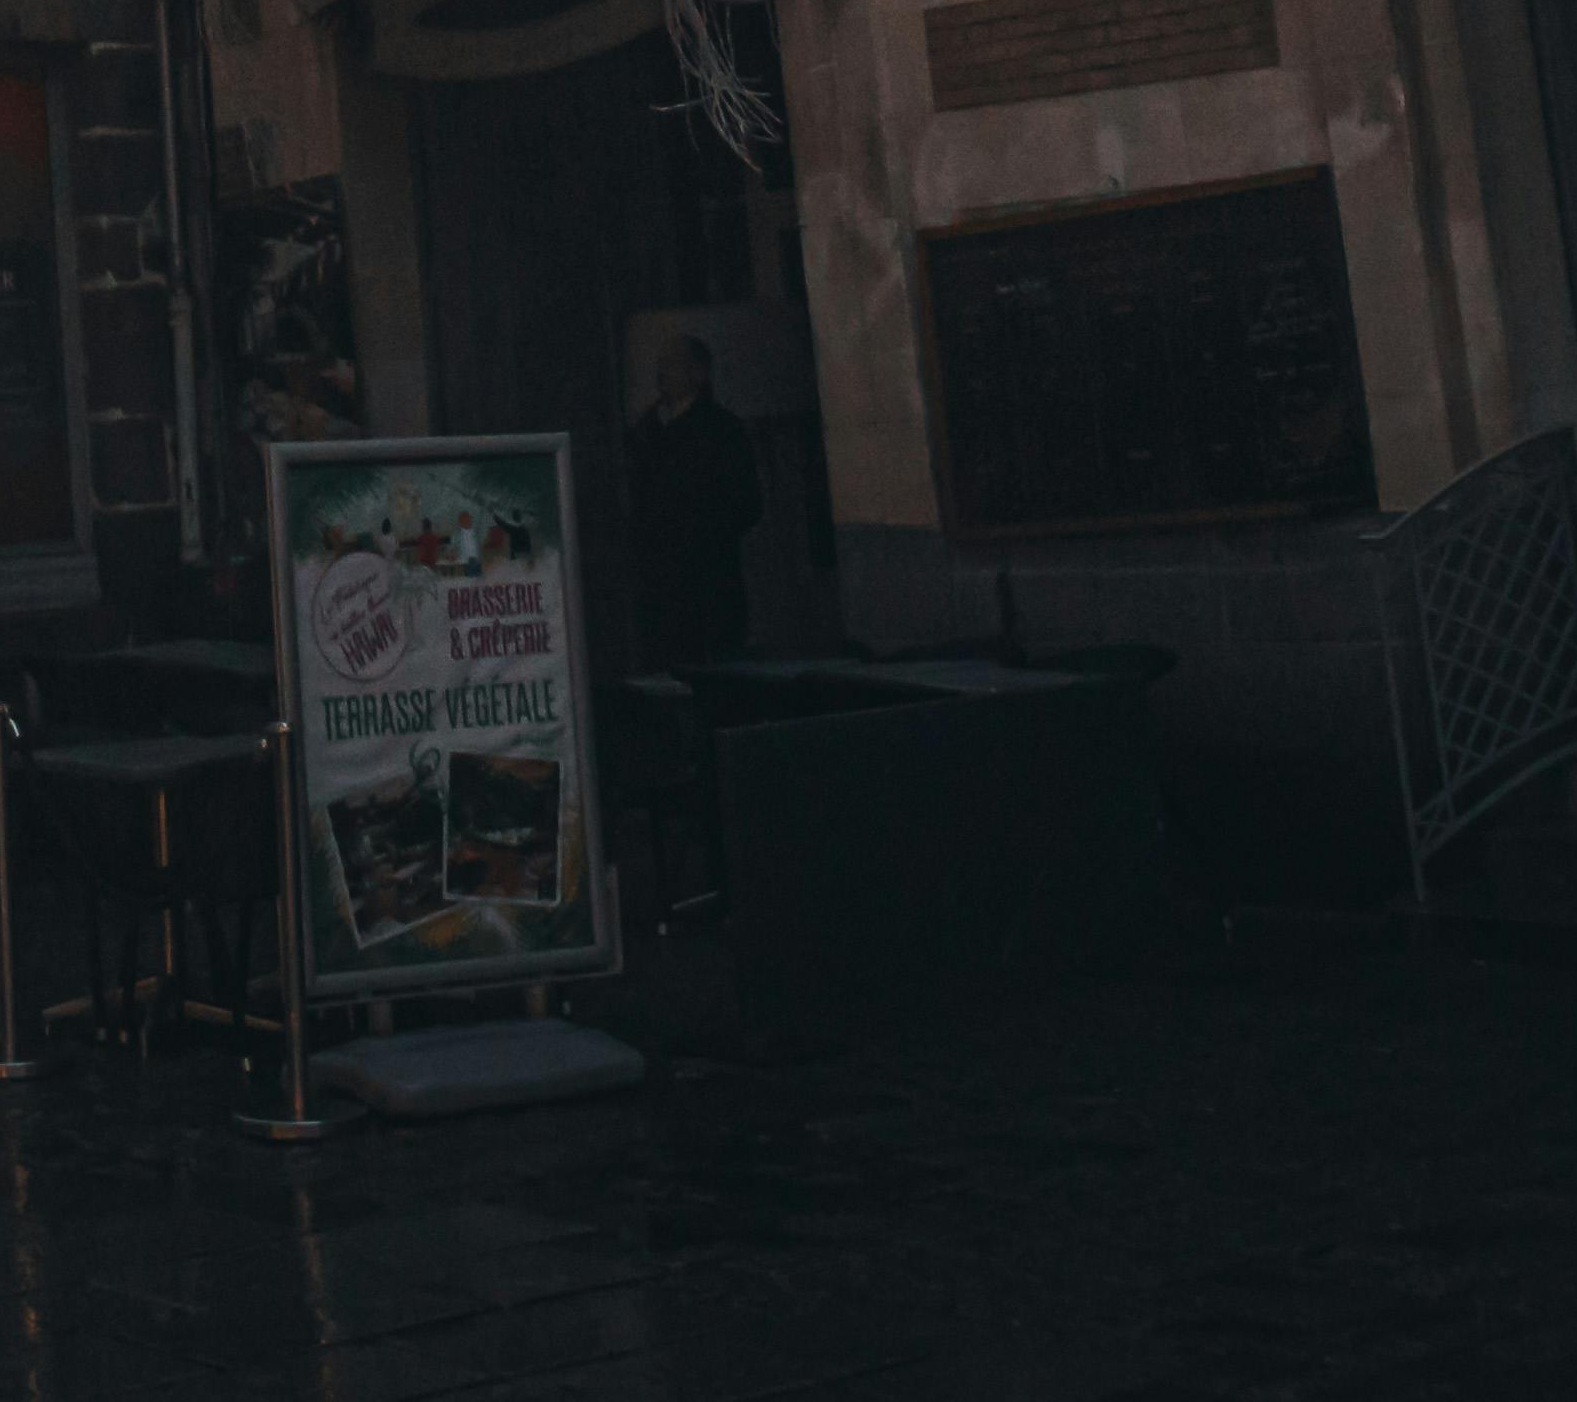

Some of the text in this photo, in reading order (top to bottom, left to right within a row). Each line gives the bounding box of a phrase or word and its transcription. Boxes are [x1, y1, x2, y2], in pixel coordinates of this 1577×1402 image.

[447, 582, 543, 620] BRASSERIE
[450, 617, 552, 662] & CRÊPERIE
[320, 675, 559, 742] TERRASSE VÉGÉTALE
